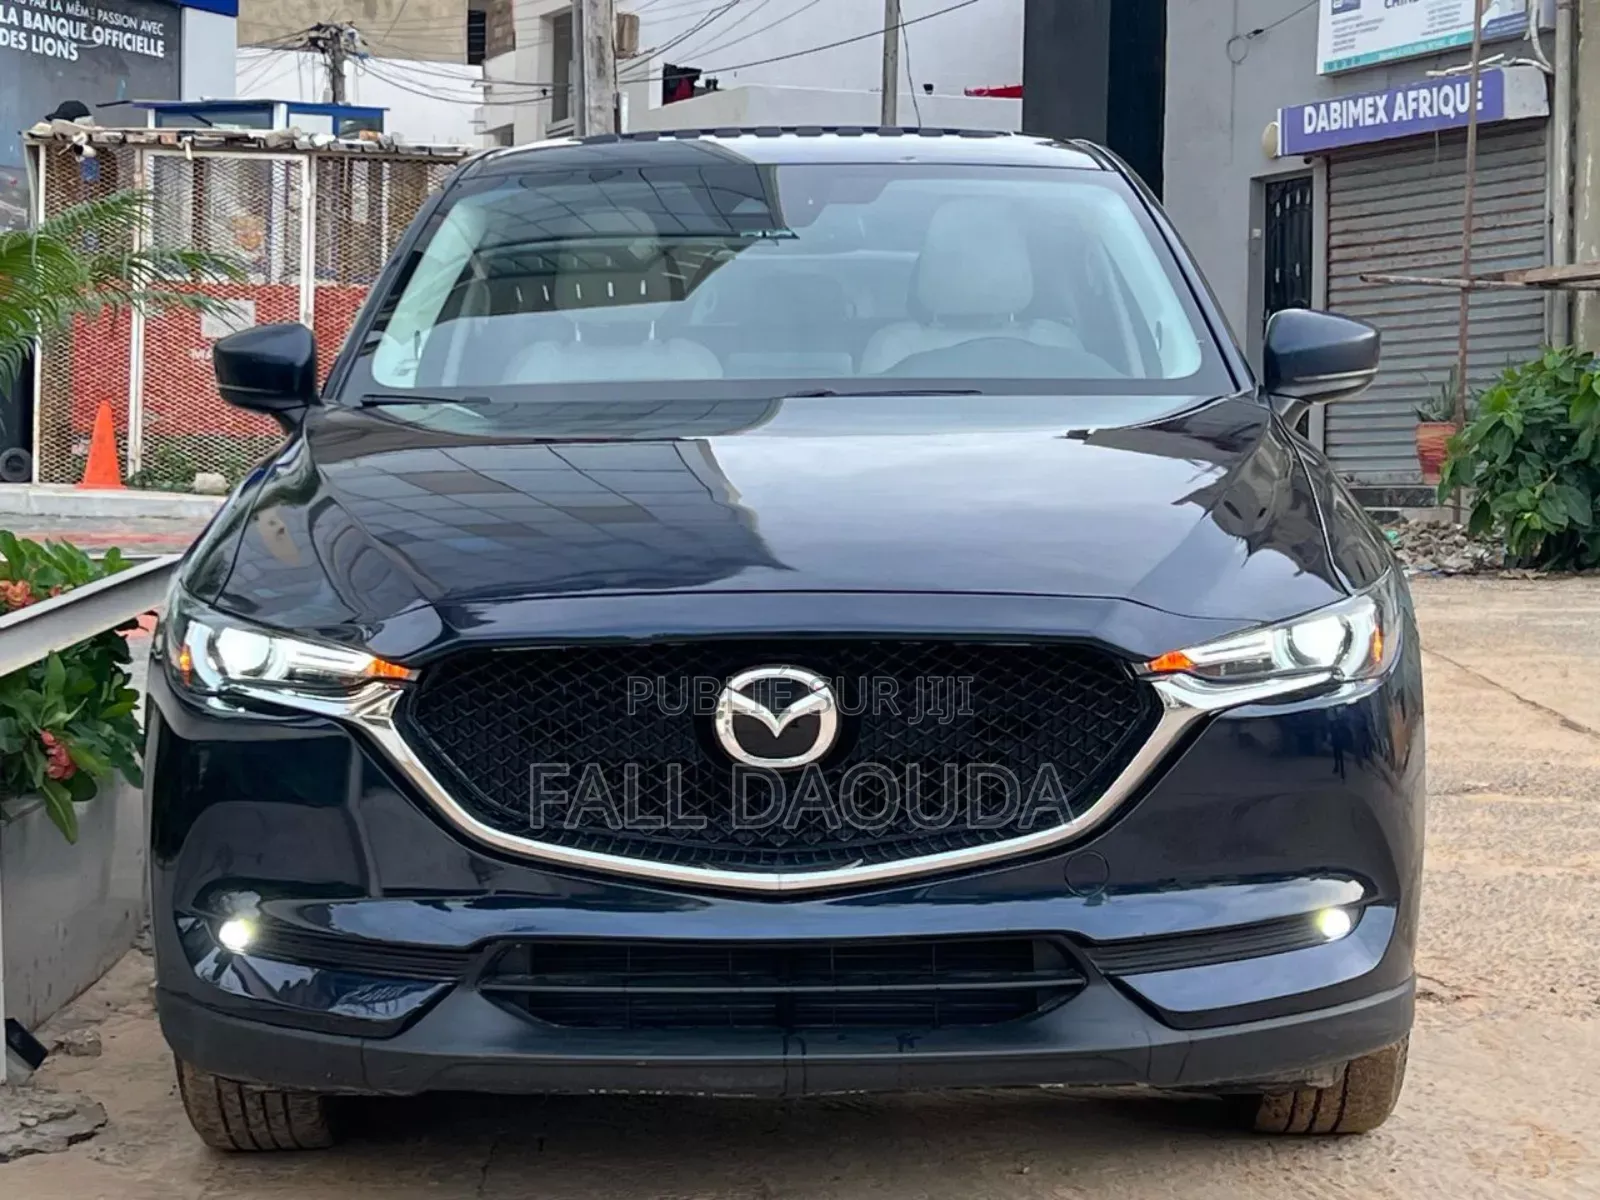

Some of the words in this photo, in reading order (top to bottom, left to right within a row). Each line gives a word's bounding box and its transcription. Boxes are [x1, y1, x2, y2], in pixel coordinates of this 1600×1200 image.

[0, 4, 19, 26] LA
[23, 9, 88, 41] BANQUE
[92, 25, 164, 58] OFFICIELLE
[50, 0, 63, 13] LA
[97, 9, 138, 30] PASSION
[140, 20, 164, 36] AVEC
[0, 27, 27, 51] DES
[32, 34, 78, 61] LIONS
[1304, 95, 1389, 134] DABIMEX
